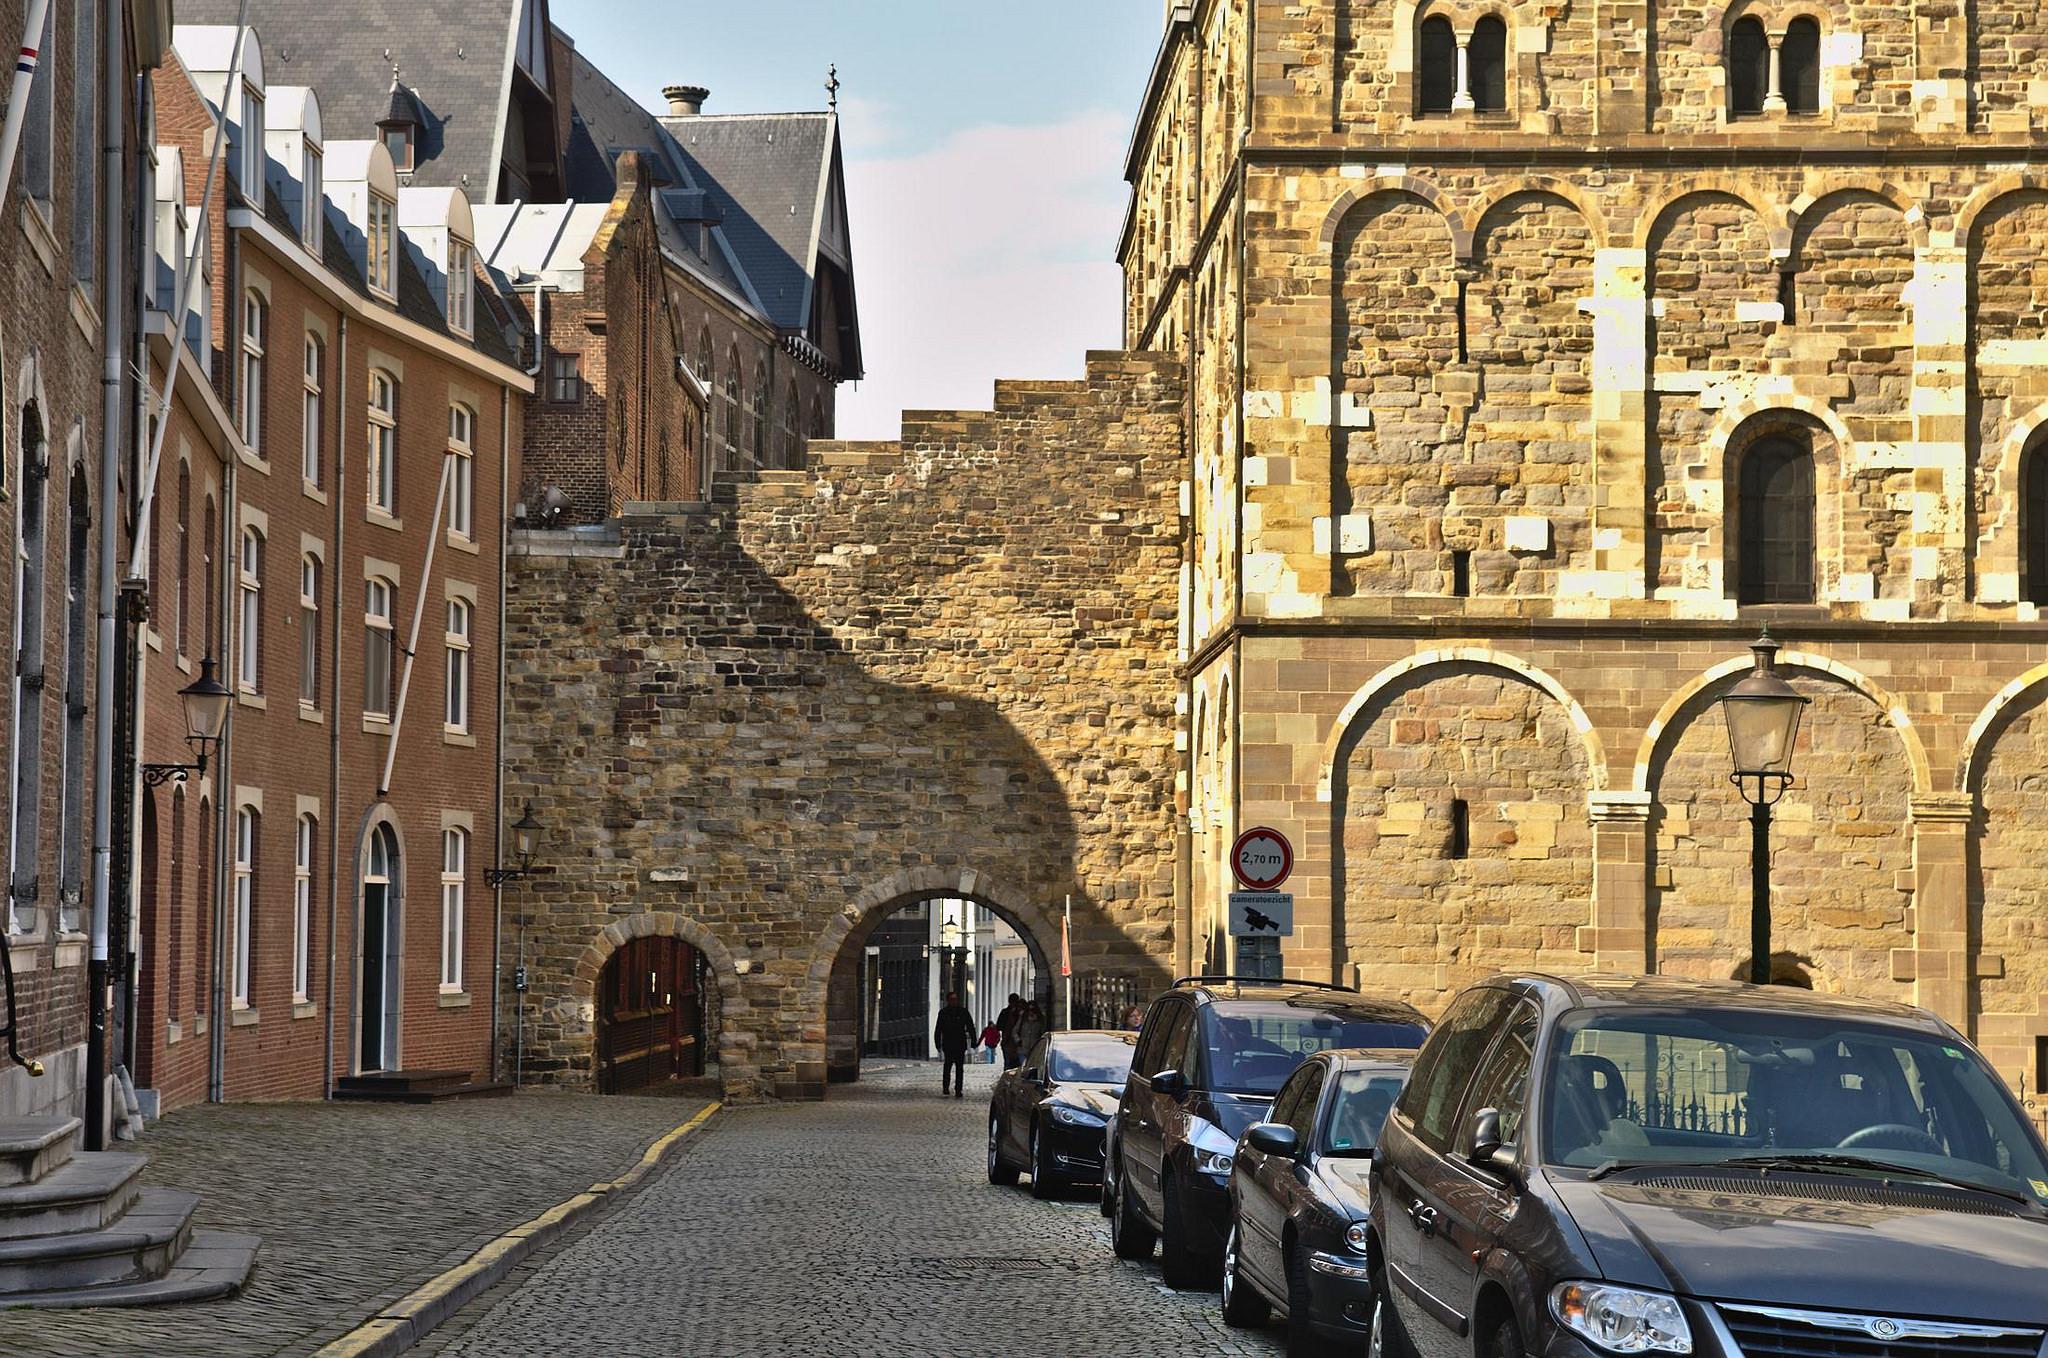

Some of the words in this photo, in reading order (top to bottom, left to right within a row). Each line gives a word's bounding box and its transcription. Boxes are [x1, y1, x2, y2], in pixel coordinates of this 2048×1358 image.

[1241, 851, 1266, 865] 2,70
[1269, 855, 1281, 864] m
[1231, 895, 1290, 904] cameratoezicht
